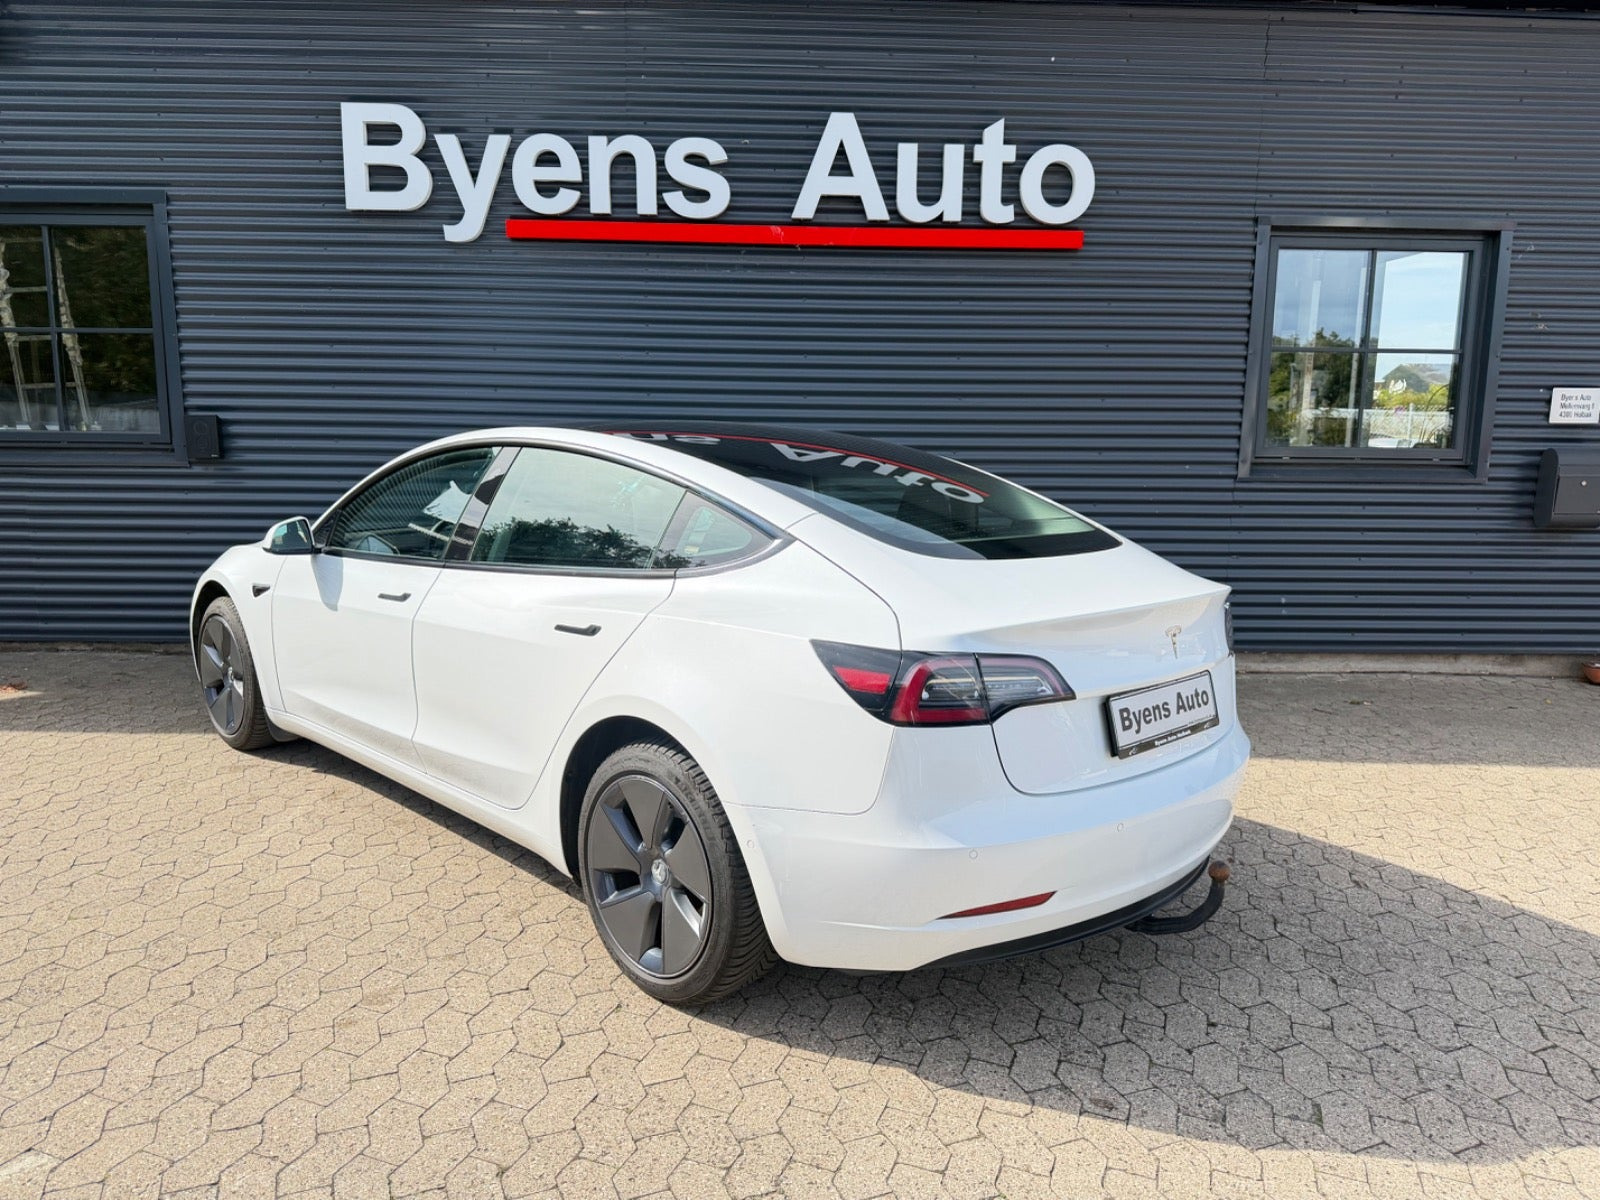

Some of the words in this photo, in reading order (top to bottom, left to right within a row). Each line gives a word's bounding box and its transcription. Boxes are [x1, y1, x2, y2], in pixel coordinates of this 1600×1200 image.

[340, 101, 731, 243] Byens
[791, 112, 1096, 226] Auto
[1118, 700, 1171, 735] Byens
[1176, 688, 1209, 715] Auto
